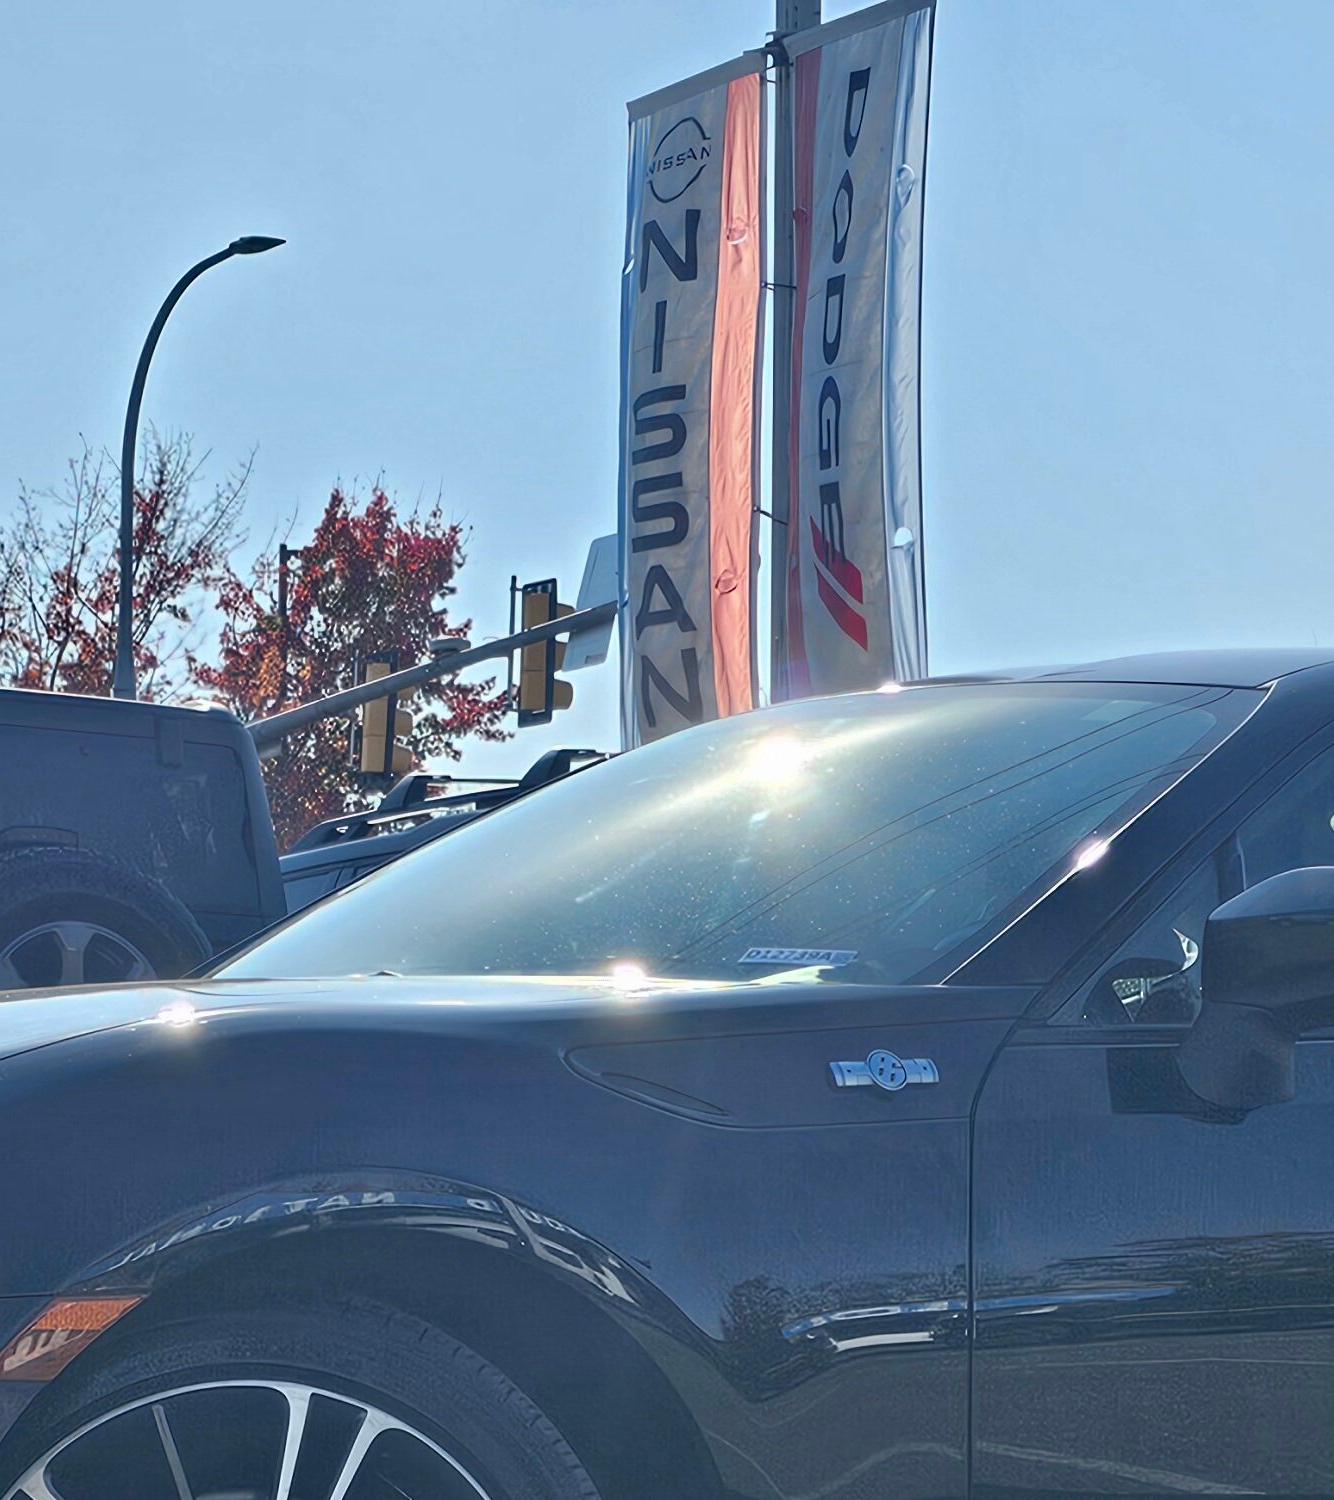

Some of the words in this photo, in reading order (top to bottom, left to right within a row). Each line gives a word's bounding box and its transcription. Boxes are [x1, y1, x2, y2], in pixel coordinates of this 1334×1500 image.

[645, 144, 712, 177] NISSAN
[819, 66, 871, 569] DODGE
[631, 208, 704, 728] NISSAN
